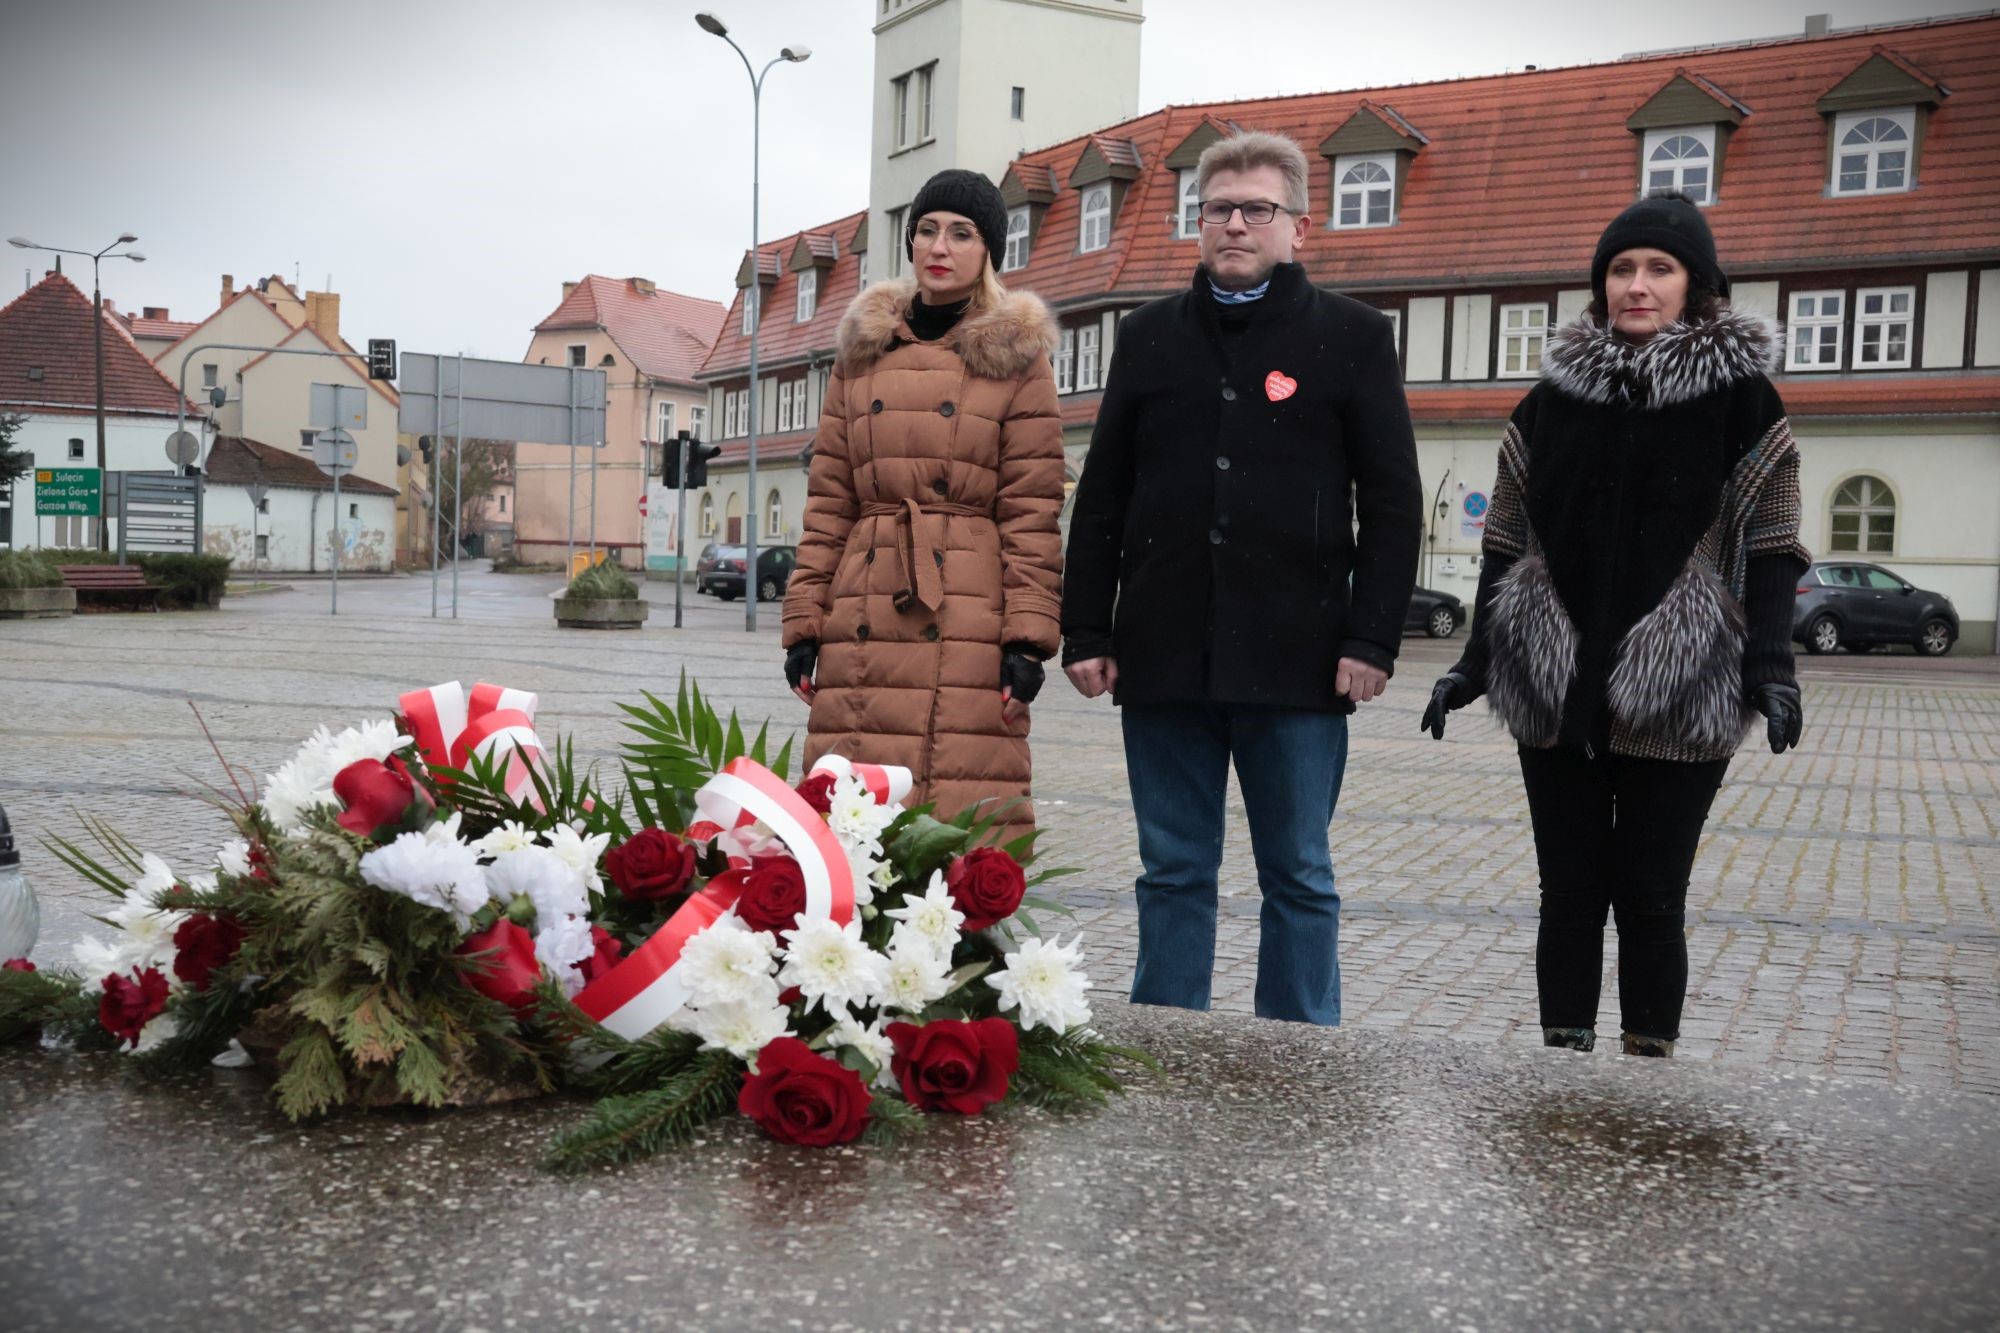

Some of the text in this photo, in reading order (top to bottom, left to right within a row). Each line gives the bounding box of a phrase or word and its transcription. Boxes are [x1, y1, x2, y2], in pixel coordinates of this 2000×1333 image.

[55, 471, 84, 483] Sulęcin
[37, 486, 89, 496] Zielona Góra
[37, 500, 66, 510] Gorzów
